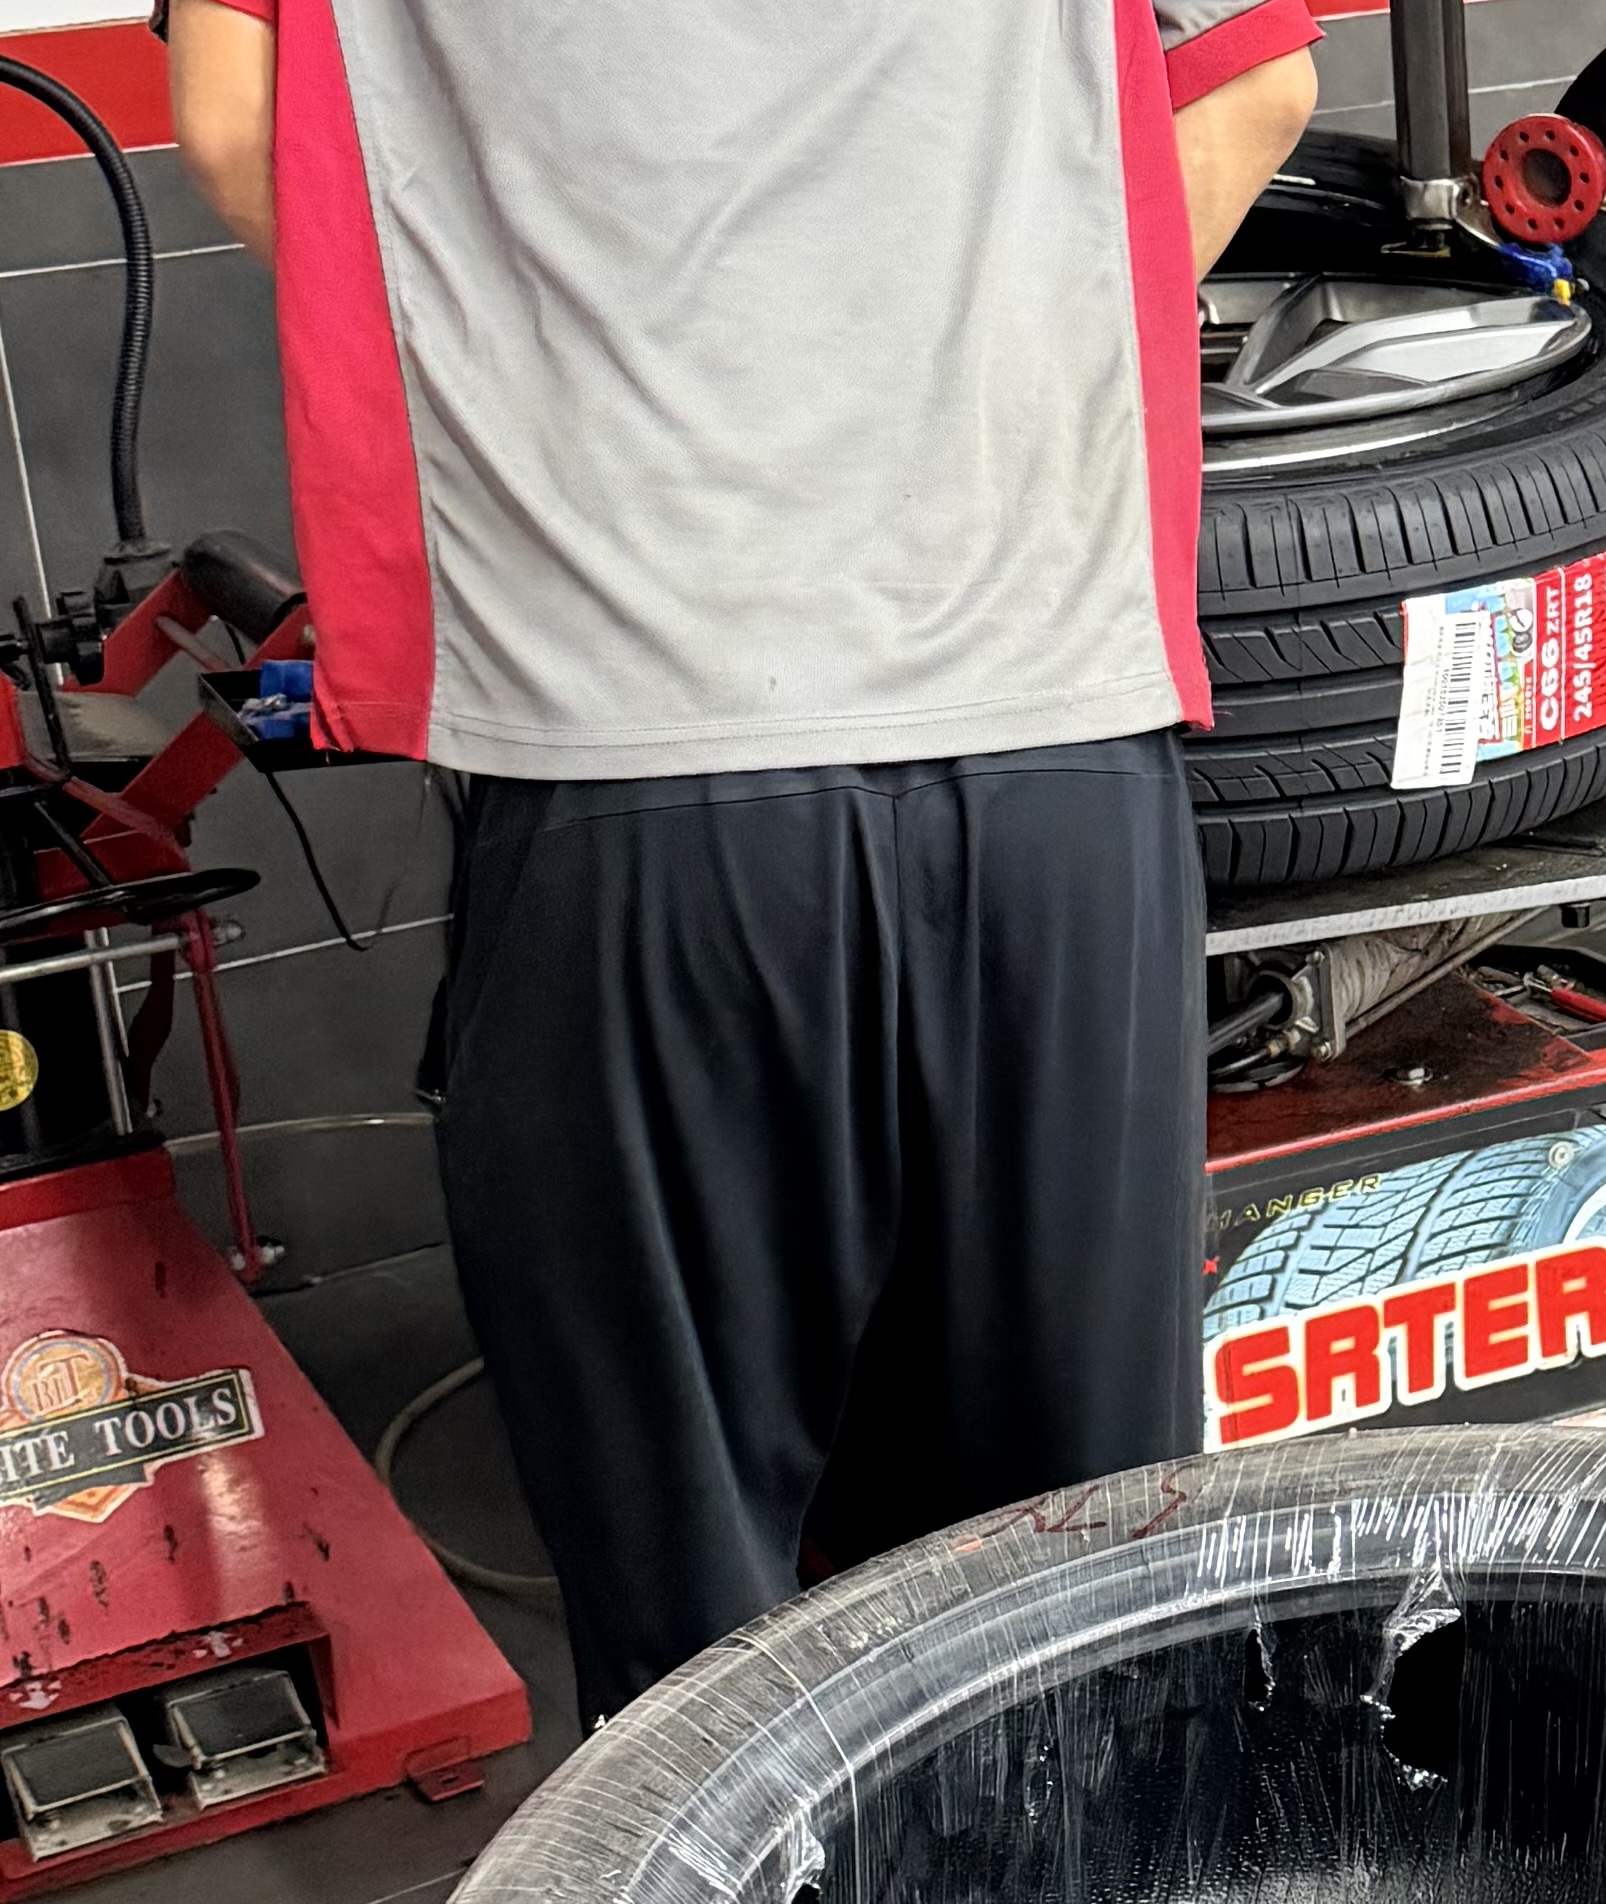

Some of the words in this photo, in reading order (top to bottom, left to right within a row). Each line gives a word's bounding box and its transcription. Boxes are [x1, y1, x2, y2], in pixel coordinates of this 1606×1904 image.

[1546, 586, 1560, 634] ZRT
[1573, 572, 1597, 722] 245/45R18
[1539, 638, 1560, 731] C66
[0, 1431, 75, 1484] ITE
[94, 1387, 237, 1457] TOOLS
